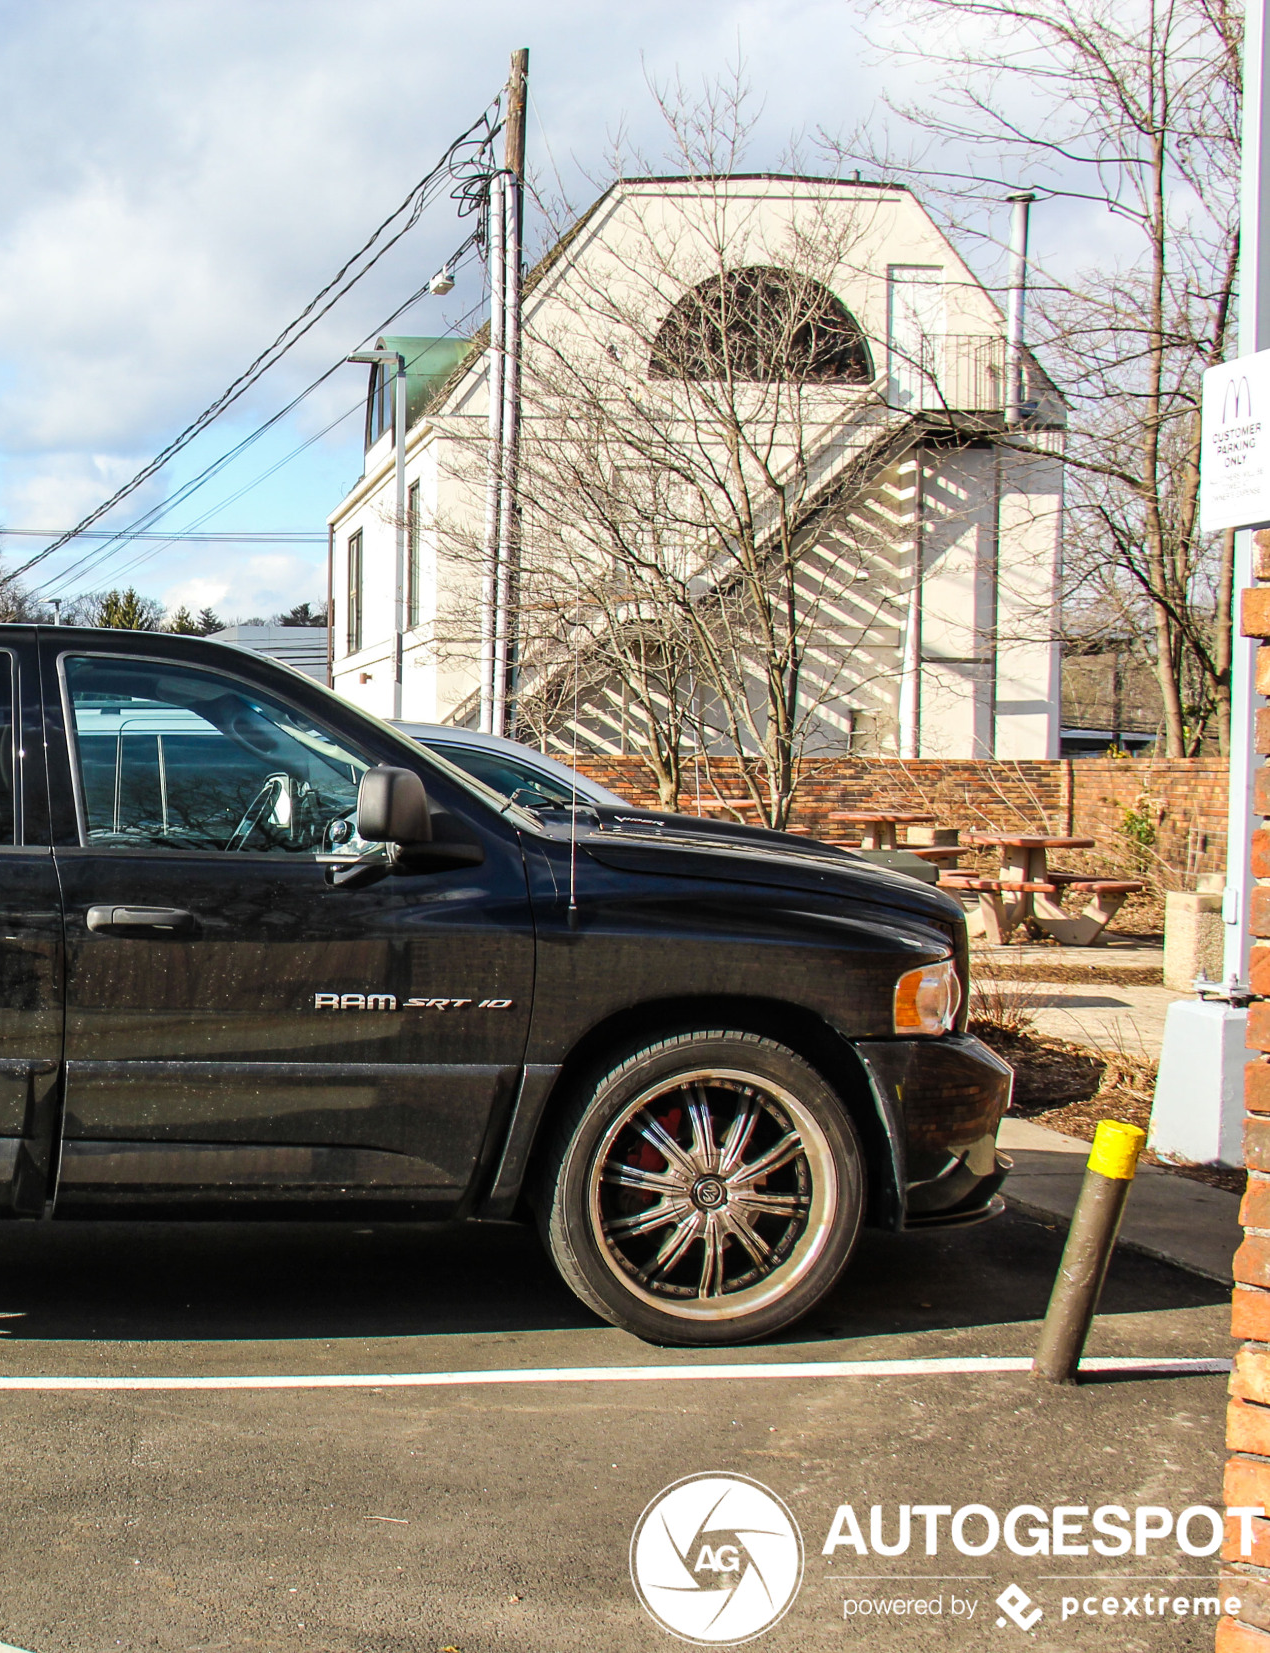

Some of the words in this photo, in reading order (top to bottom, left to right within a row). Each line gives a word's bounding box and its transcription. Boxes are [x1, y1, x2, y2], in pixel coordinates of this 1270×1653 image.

[1212, 422, 1262, 444] CUSTOMER
[1216, 437, 1256, 456] PARKING
[1225, 454, 1247, 468] ONLY
[314, 993, 397, 1010] RAM
[403, 998, 472, 1011] SRT
[478, 999, 513, 1009] 10
